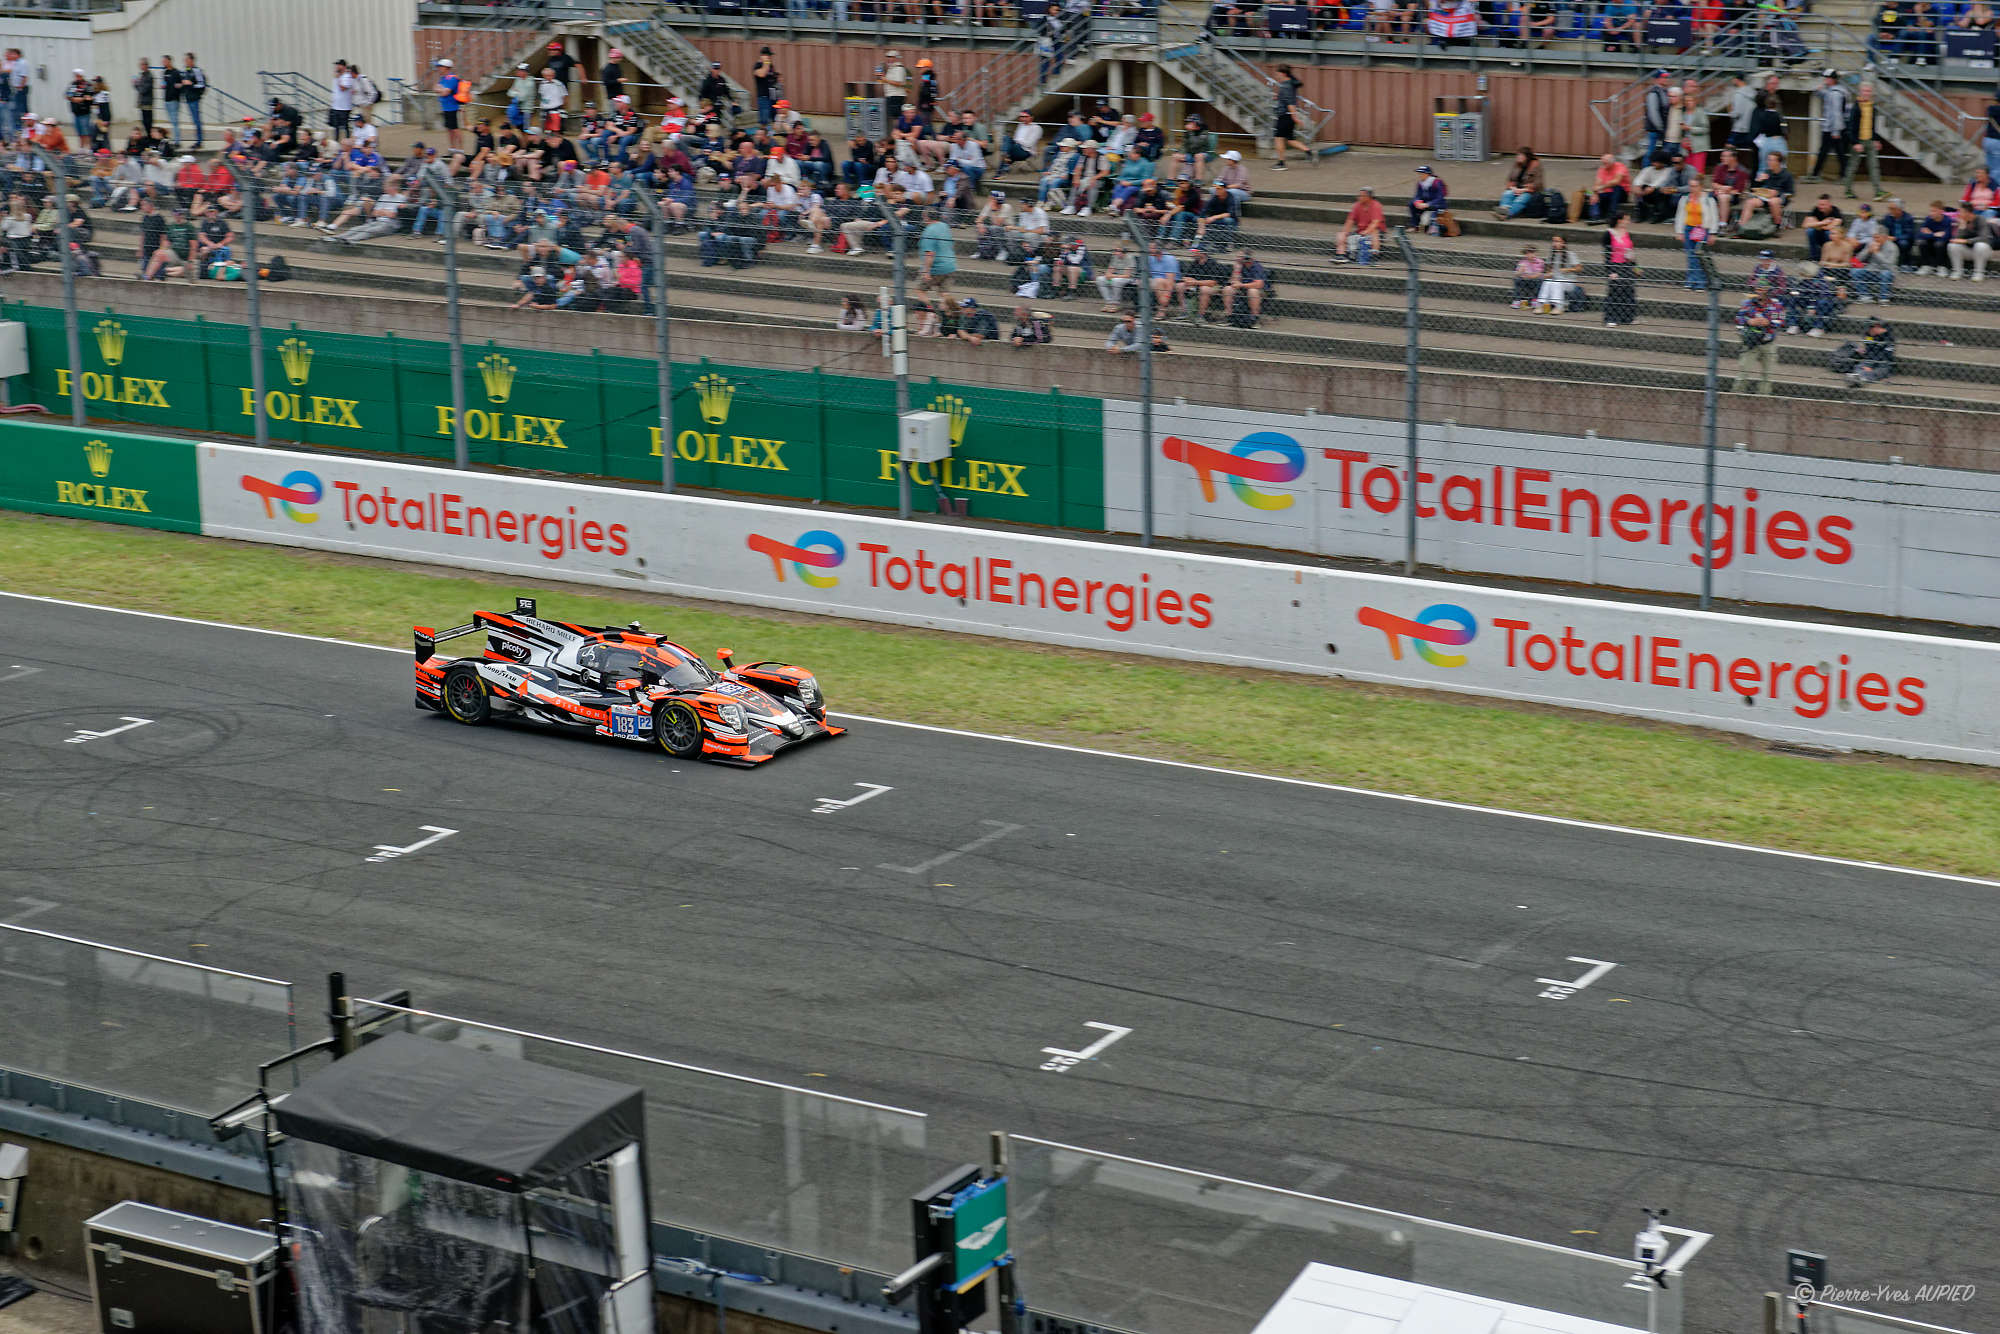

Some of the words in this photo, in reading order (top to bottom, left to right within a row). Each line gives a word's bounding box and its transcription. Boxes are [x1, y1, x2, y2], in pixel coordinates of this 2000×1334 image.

[333, 480, 629, 560] TotalEnergies
[1323, 447, 1855, 570] TotalEnergies
[858, 542, 1213, 633] TotalEnergies
[1492, 617, 1927, 719] TotalEnergies
[615, 715, 634, 734] 183
[639, 717, 653, 728] P2
